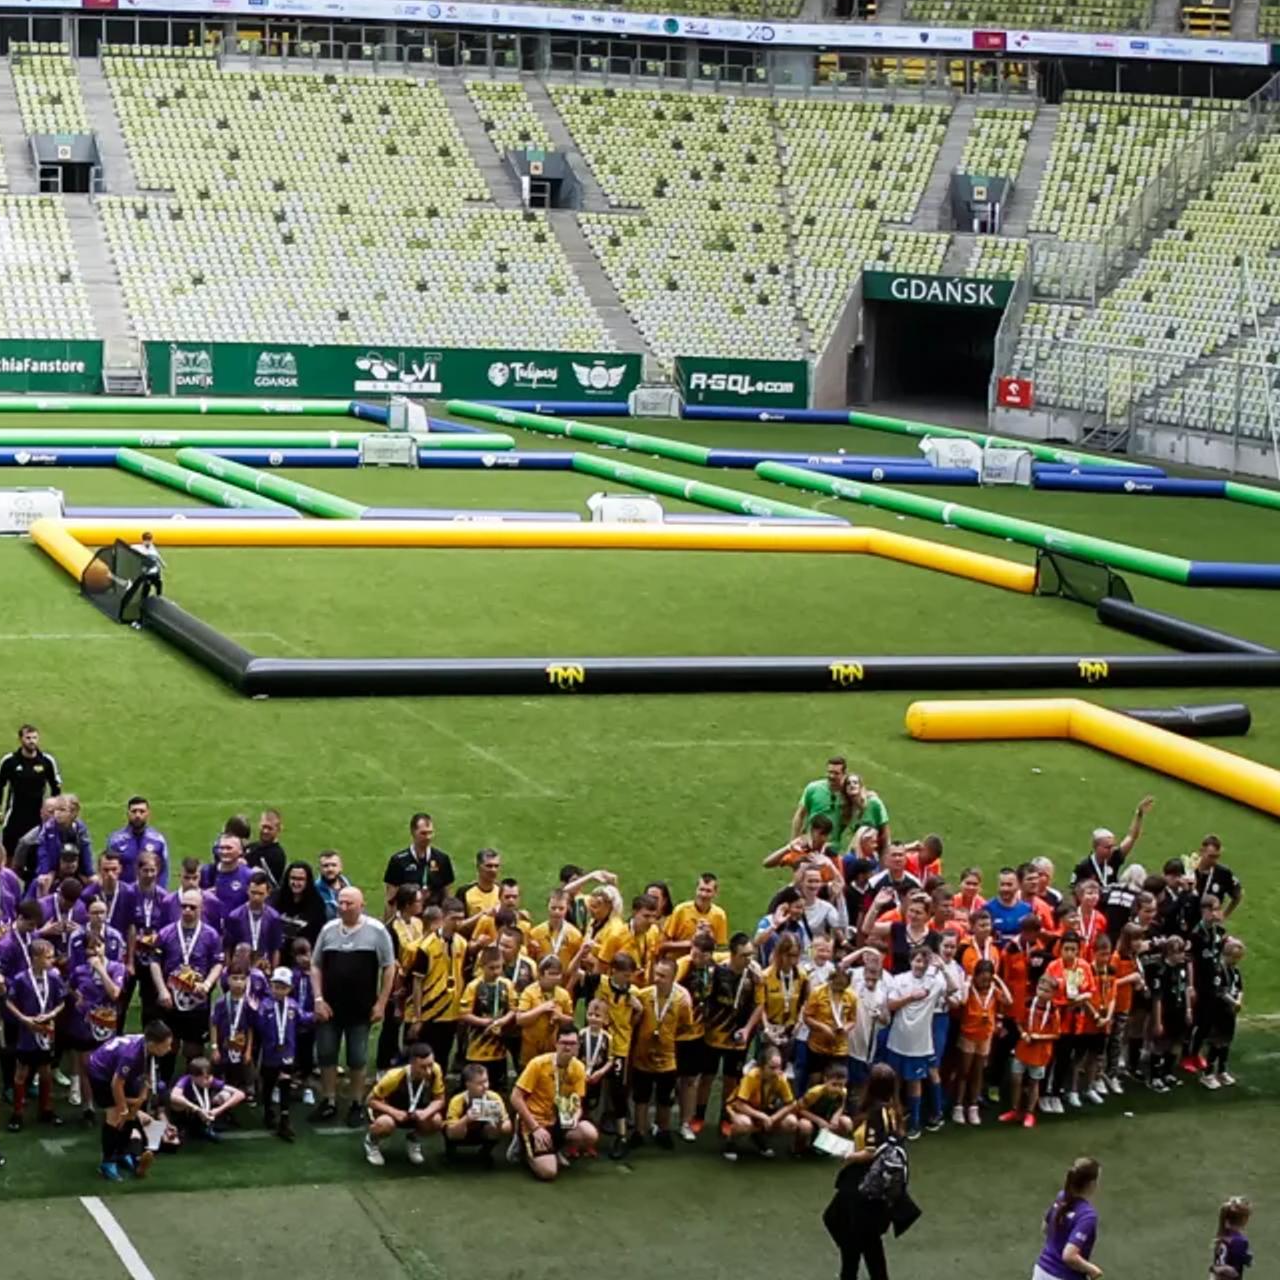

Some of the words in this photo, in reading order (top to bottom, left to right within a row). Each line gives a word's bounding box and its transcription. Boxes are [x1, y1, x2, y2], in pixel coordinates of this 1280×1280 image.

[891, 278, 995, 305] GDAŃSK
[546, 664, 585, 684] TMN
[828, 661, 864, 682] TMN
